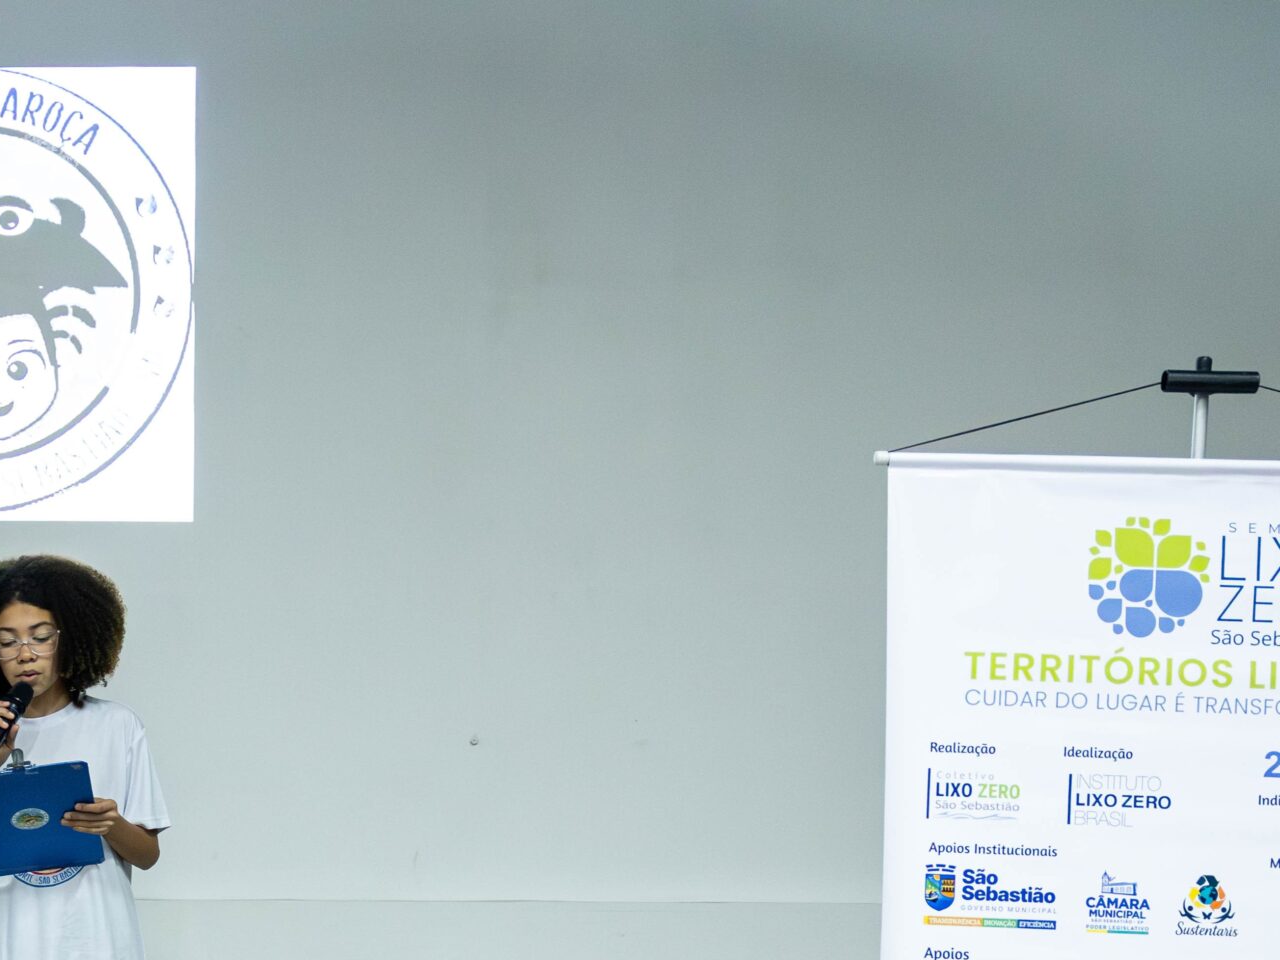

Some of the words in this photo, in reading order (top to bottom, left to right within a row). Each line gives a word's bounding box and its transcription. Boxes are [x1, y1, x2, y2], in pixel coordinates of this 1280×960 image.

[1211, 629, 1244, 645] São
[964, 647, 1233, 688] TERRITÓRIOS
[965, 688, 1047, 708] CUIDAR
[1056, 691, 1088, 709] DO
[1096, 693, 1166, 712] LUGAR
[1175, 692, 1185, 713] É
[930, 742, 996, 757] Realização
[1063, 746, 1133, 762] Idealização
[936, 770, 995, 781] Coletivo
[1076, 774, 1162, 792] INSTITUTO
[936, 782, 973, 797] LIXO
[978, 783, 1020, 799] ZERO
[935, 800, 956, 810] São
[961, 800, 1020, 812] Sebastião
[1075, 793, 1117, 808] LIXO
[1121, 794, 1171, 809] ZERO
[1074, 809, 1133, 827] BRASIL
[929, 842, 970, 855] Apoios
[974, 843, 1058, 857] Institucionais
[962, 869, 998, 885] São
[962, 885, 1056, 903] Sebastião
[1086, 895, 1150, 910] CÂMARA
[1089, 909, 1146, 919] MUNICIPAL
[1175, 921, 1238, 937] Sustentaris
